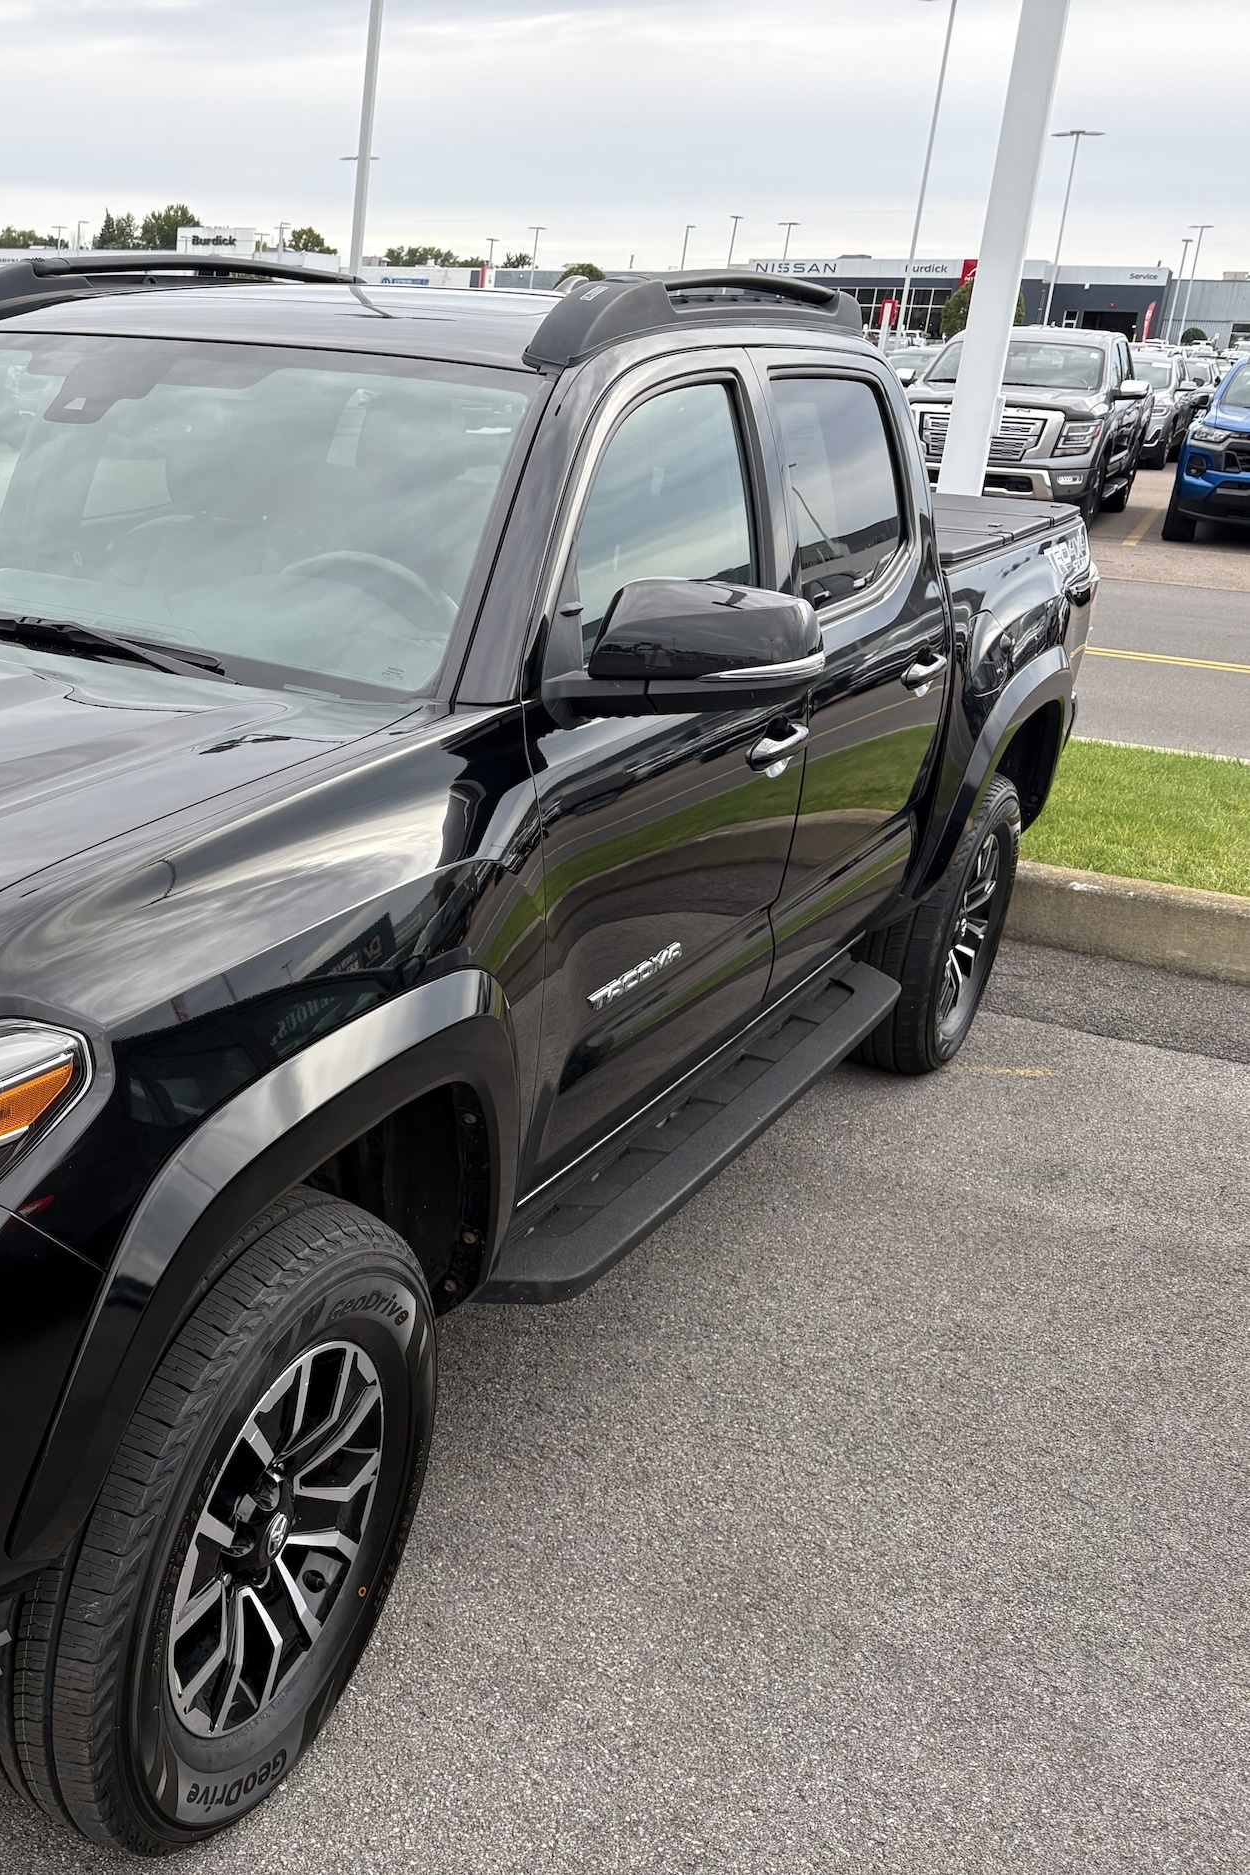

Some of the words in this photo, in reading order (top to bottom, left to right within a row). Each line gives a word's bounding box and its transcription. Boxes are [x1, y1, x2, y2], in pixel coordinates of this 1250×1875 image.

[191, 235, 237, 246] Burdick
[755, 262, 837, 274] NISSAN
[905, 264, 948, 274] urdick
[1044, 542, 1071, 575] TRD
[586, 941, 682, 1011] TACOMA
[330, 1290, 410, 1326] GeoDrive
[187, 1749, 287, 1813] GeoDrive
